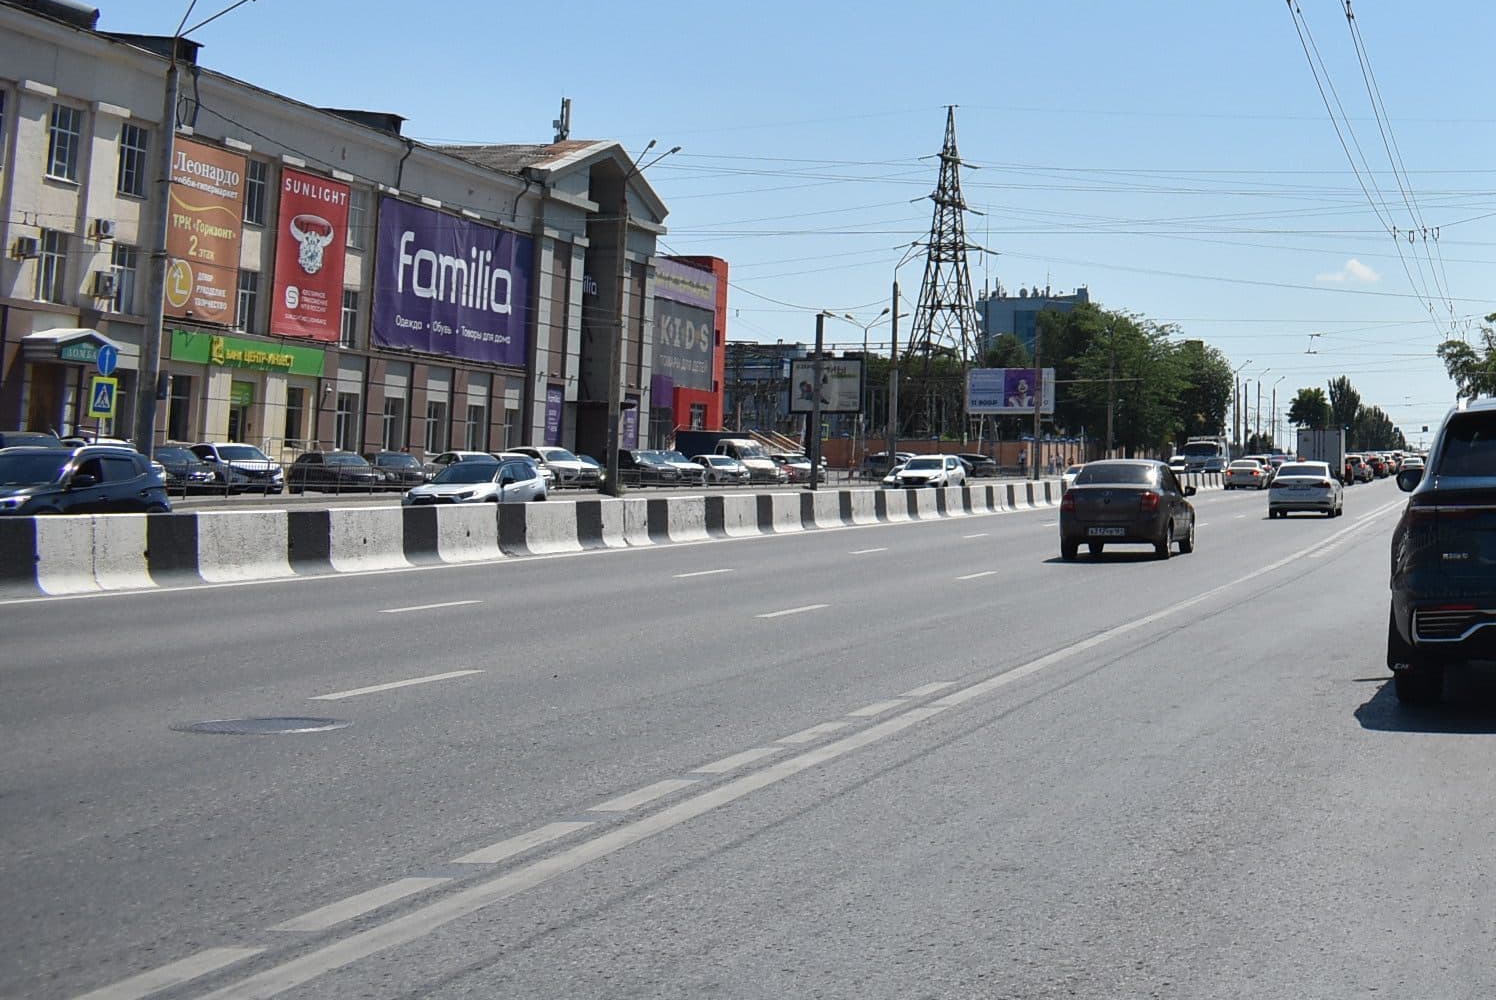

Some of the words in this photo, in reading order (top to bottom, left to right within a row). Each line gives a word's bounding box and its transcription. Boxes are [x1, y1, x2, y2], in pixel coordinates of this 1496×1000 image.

[173, 152, 240, 187] Леонардо
[285, 177, 347, 206] SUNLIGHT
[188, 234, 198, 256] 2
[397, 230, 512, 316] familia
[583, 274, 598, 296] ilia
[395, 314, 423, 331] Одежда
[432, 320, 452, 337] Обувь
[461, 325, 482, 342] Товары
[66, 348, 98, 361] ЛОМБА
